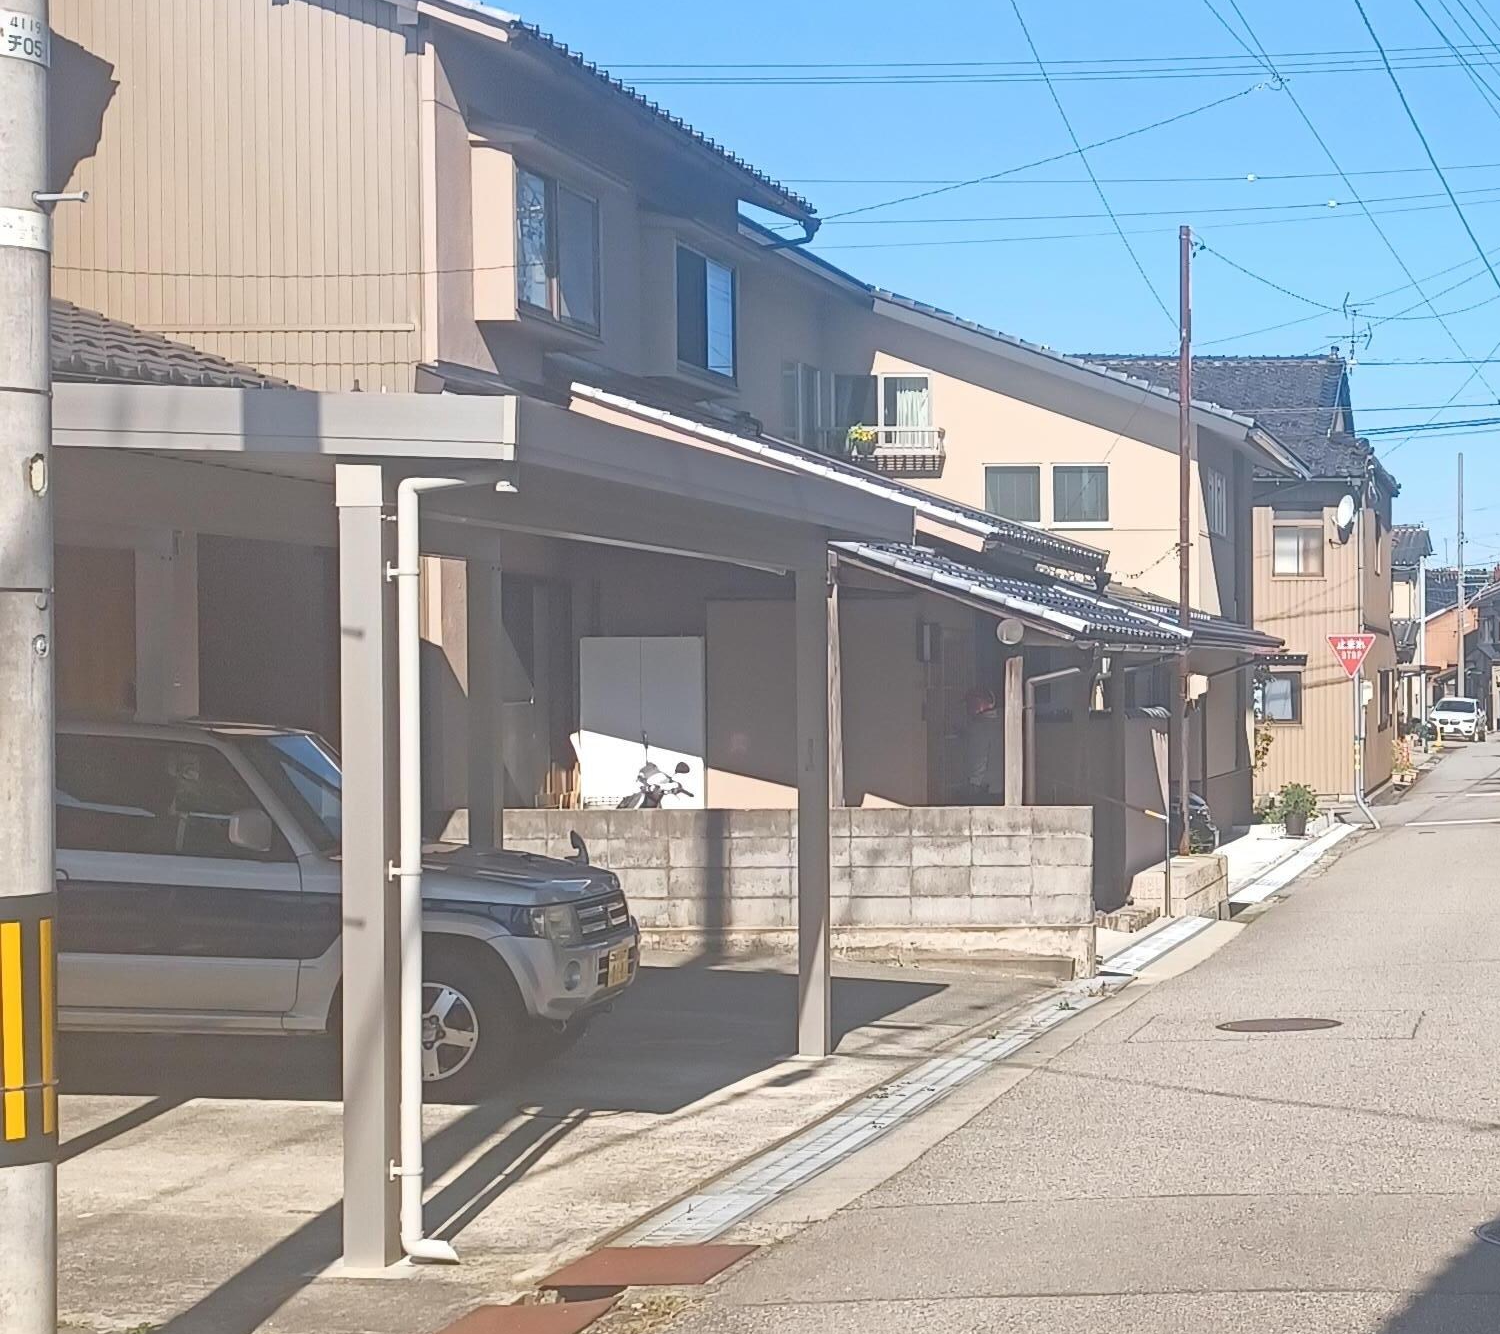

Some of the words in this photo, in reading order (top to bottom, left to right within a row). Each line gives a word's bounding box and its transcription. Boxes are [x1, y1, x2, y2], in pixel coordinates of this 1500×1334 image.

[1336, 638, 1367, 650] 止まれ
[1341, 650, 1363, 660] STOP
